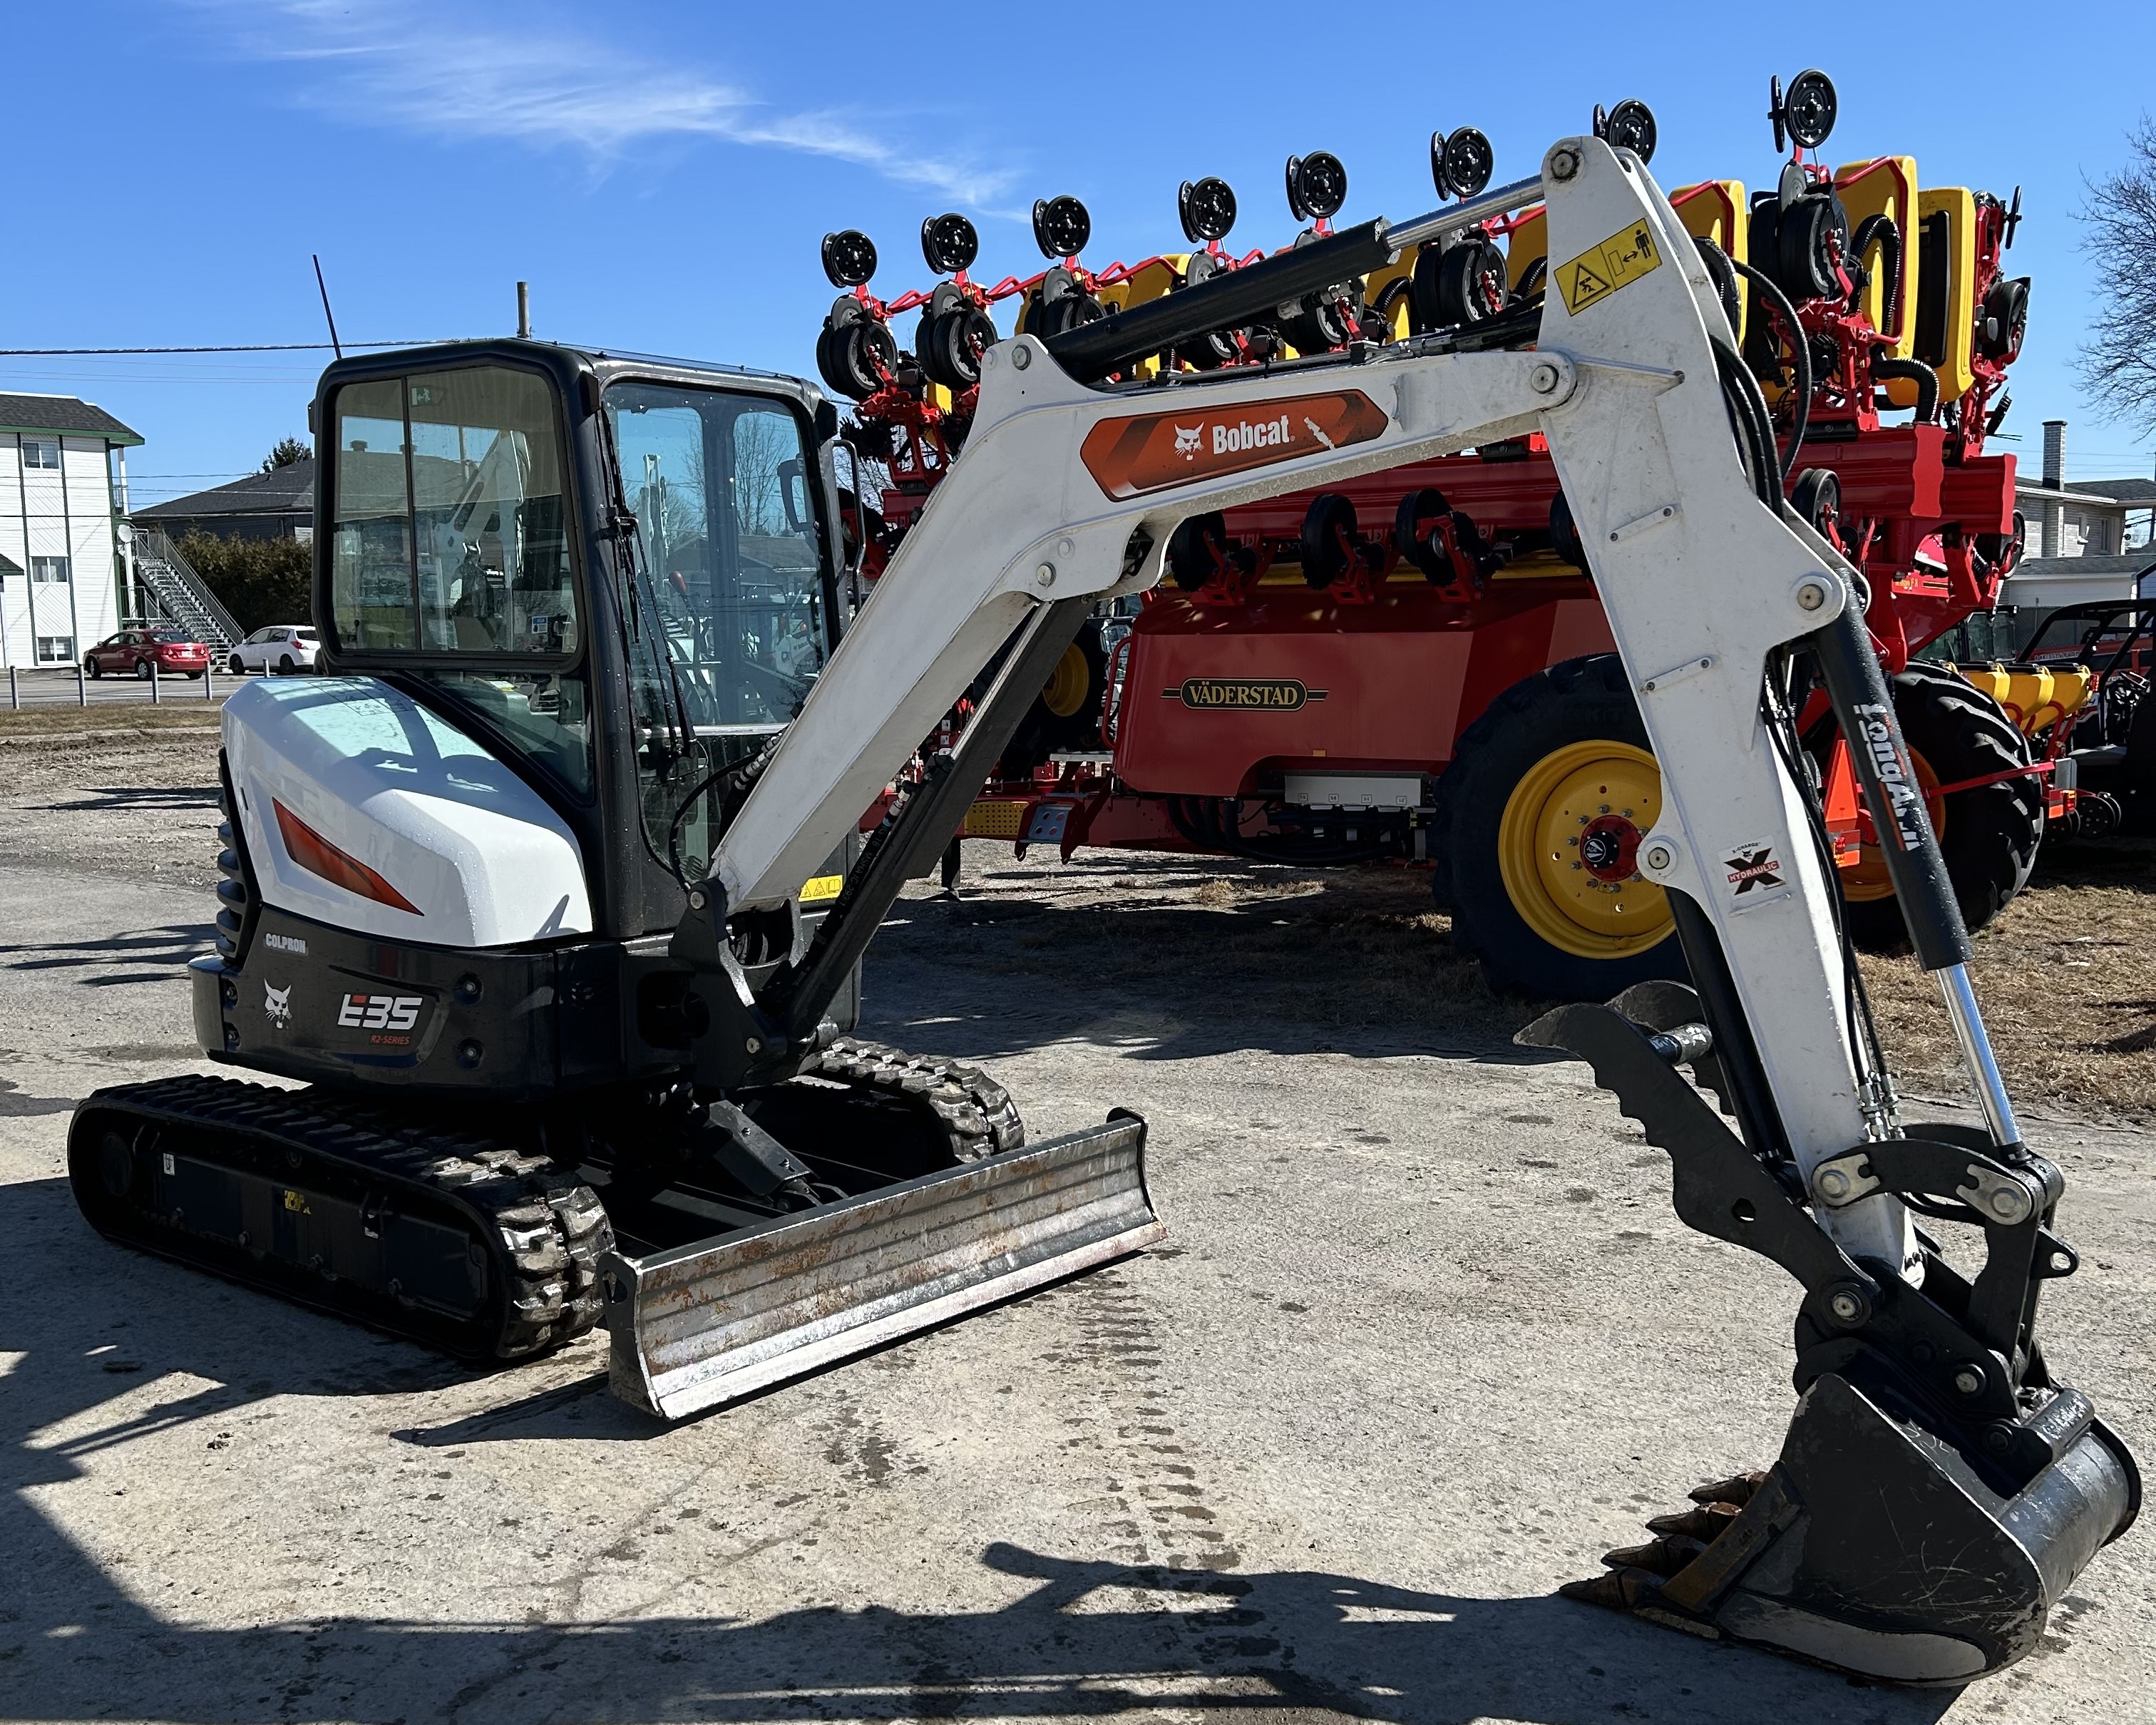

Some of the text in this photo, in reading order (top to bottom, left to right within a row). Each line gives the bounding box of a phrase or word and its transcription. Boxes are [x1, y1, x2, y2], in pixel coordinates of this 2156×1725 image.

[1213, 415, 1290, 455] Bobcat
[1189, 680, 1298, 705] VÄDERSTAD
[1729, 861, 1778, 881] HYDRAULIC
[265, 933, 307, 953] COLPRON
[337, 994, 423, 1030] E35
[370, 1034, 411, 1045] R2-SERIES
